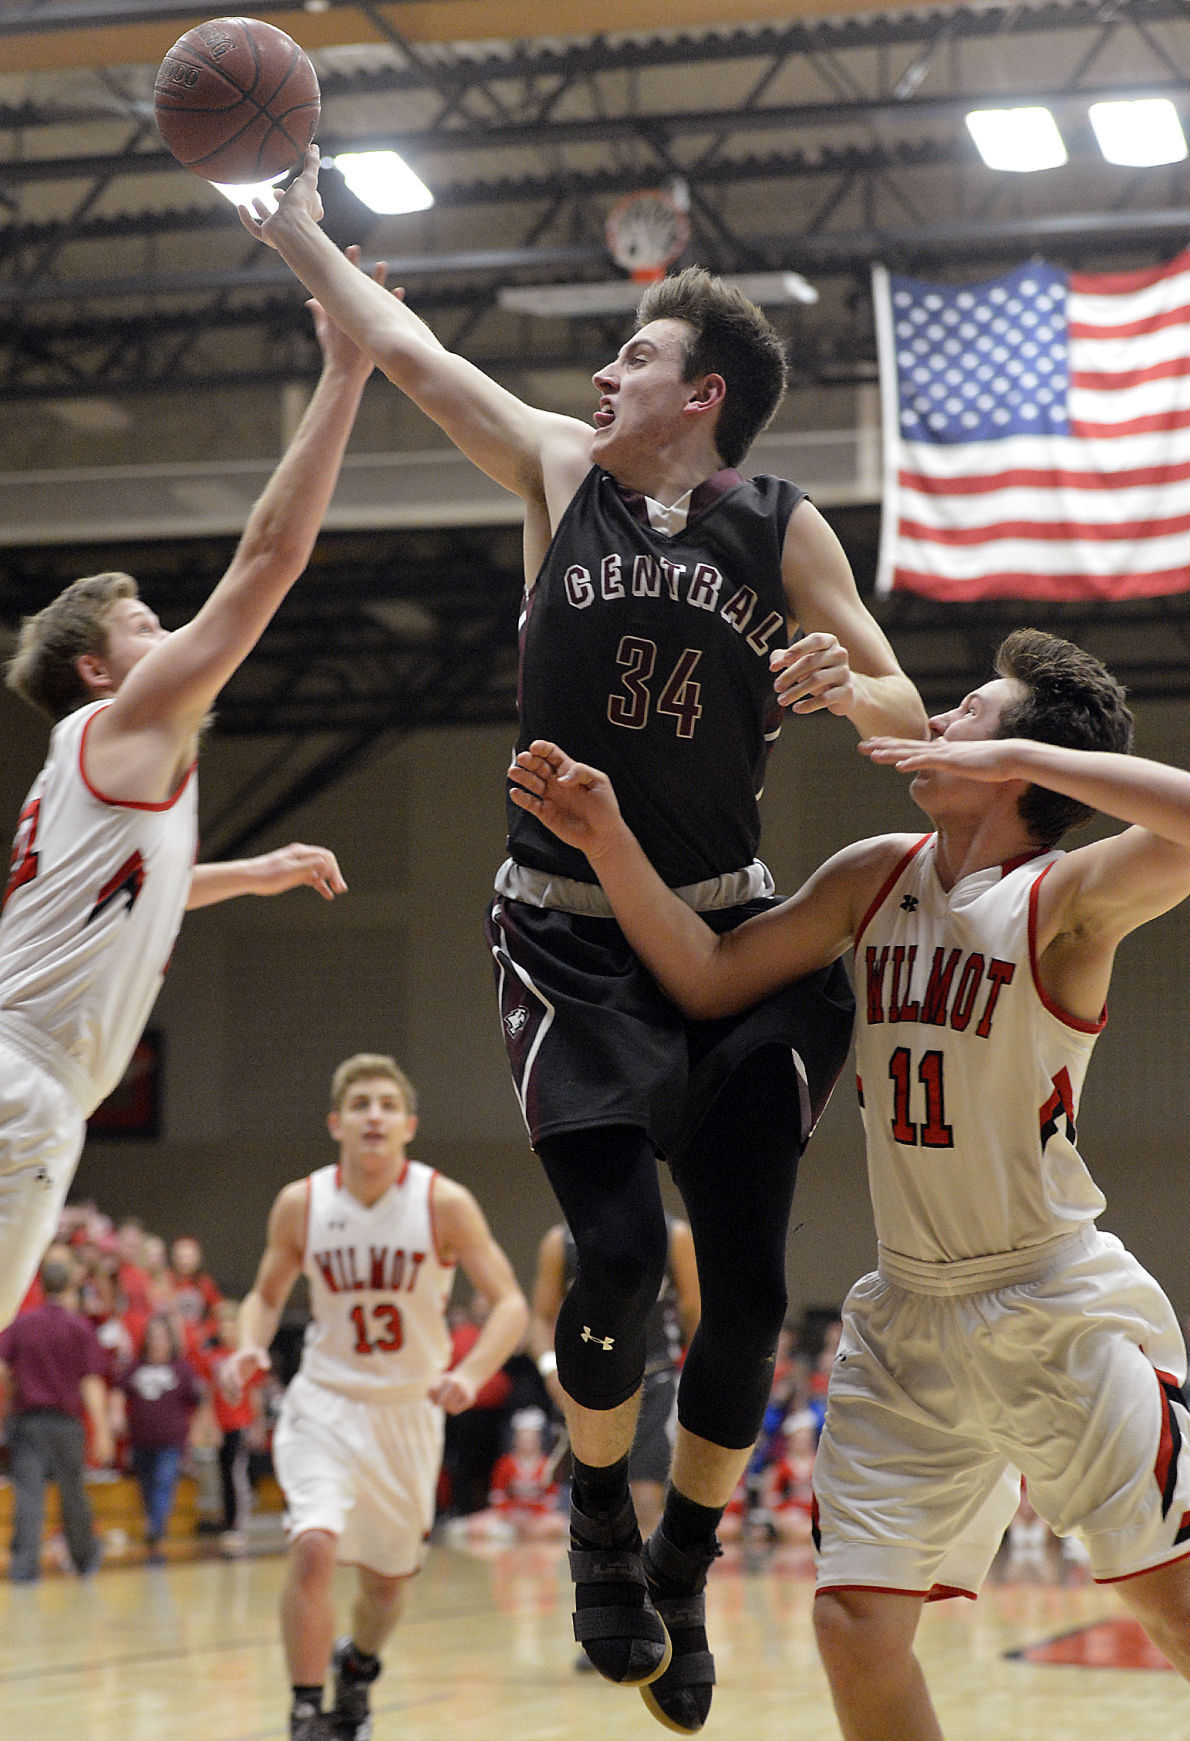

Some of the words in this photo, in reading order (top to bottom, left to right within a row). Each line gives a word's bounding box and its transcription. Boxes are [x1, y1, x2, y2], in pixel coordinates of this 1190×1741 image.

[563, 553, 784, 656] CENTRAL
[607, 635, 702, 739] 34
[866, 945, 1016, 1039] WILMOT
[889, 1046, 954, 1149] 11
[313, 1247, 426, 1293] WILMOT
[350, 1303, 405, 1354] 13
